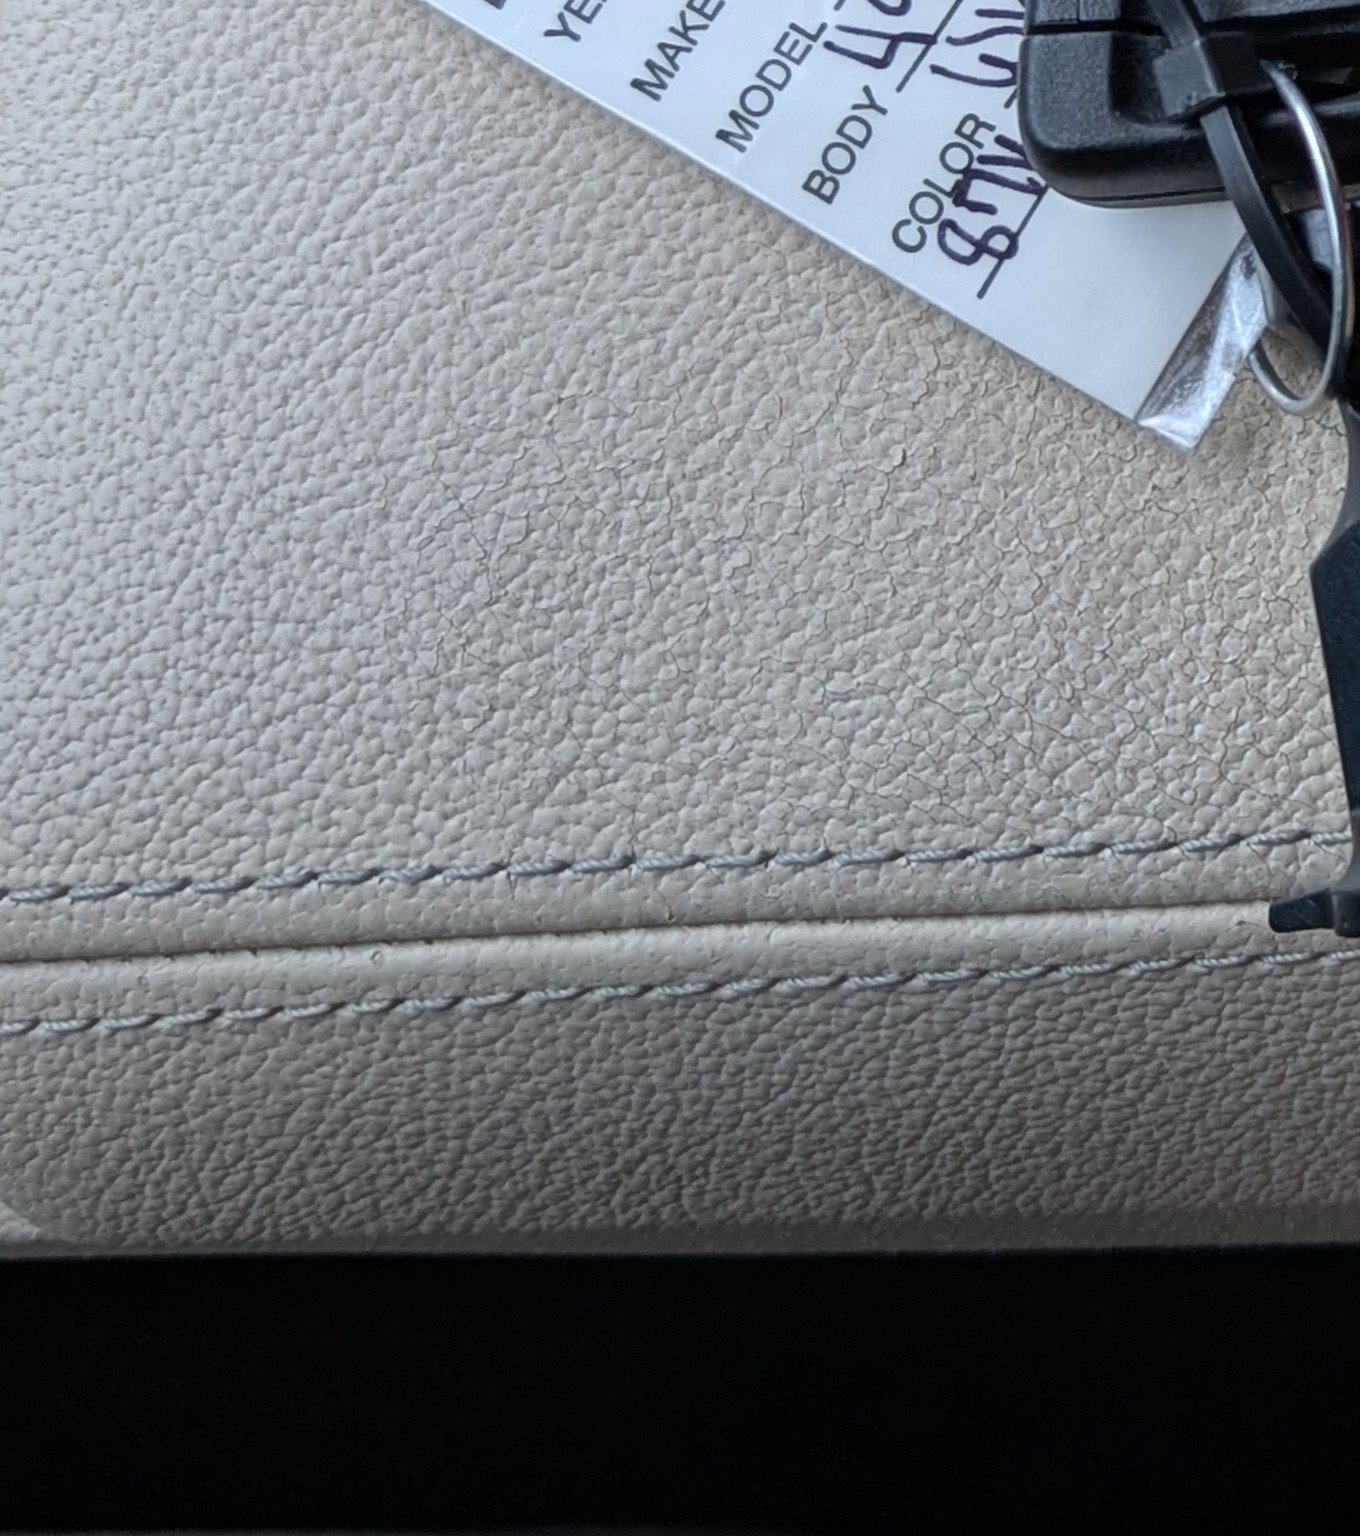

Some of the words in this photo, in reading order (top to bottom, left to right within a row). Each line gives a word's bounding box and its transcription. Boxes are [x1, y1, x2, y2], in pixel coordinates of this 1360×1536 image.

[714, 21, 829, 154] MODEL
[801, 84, 889, 205] BODY
[891, 112, 997, 254] COLOR
